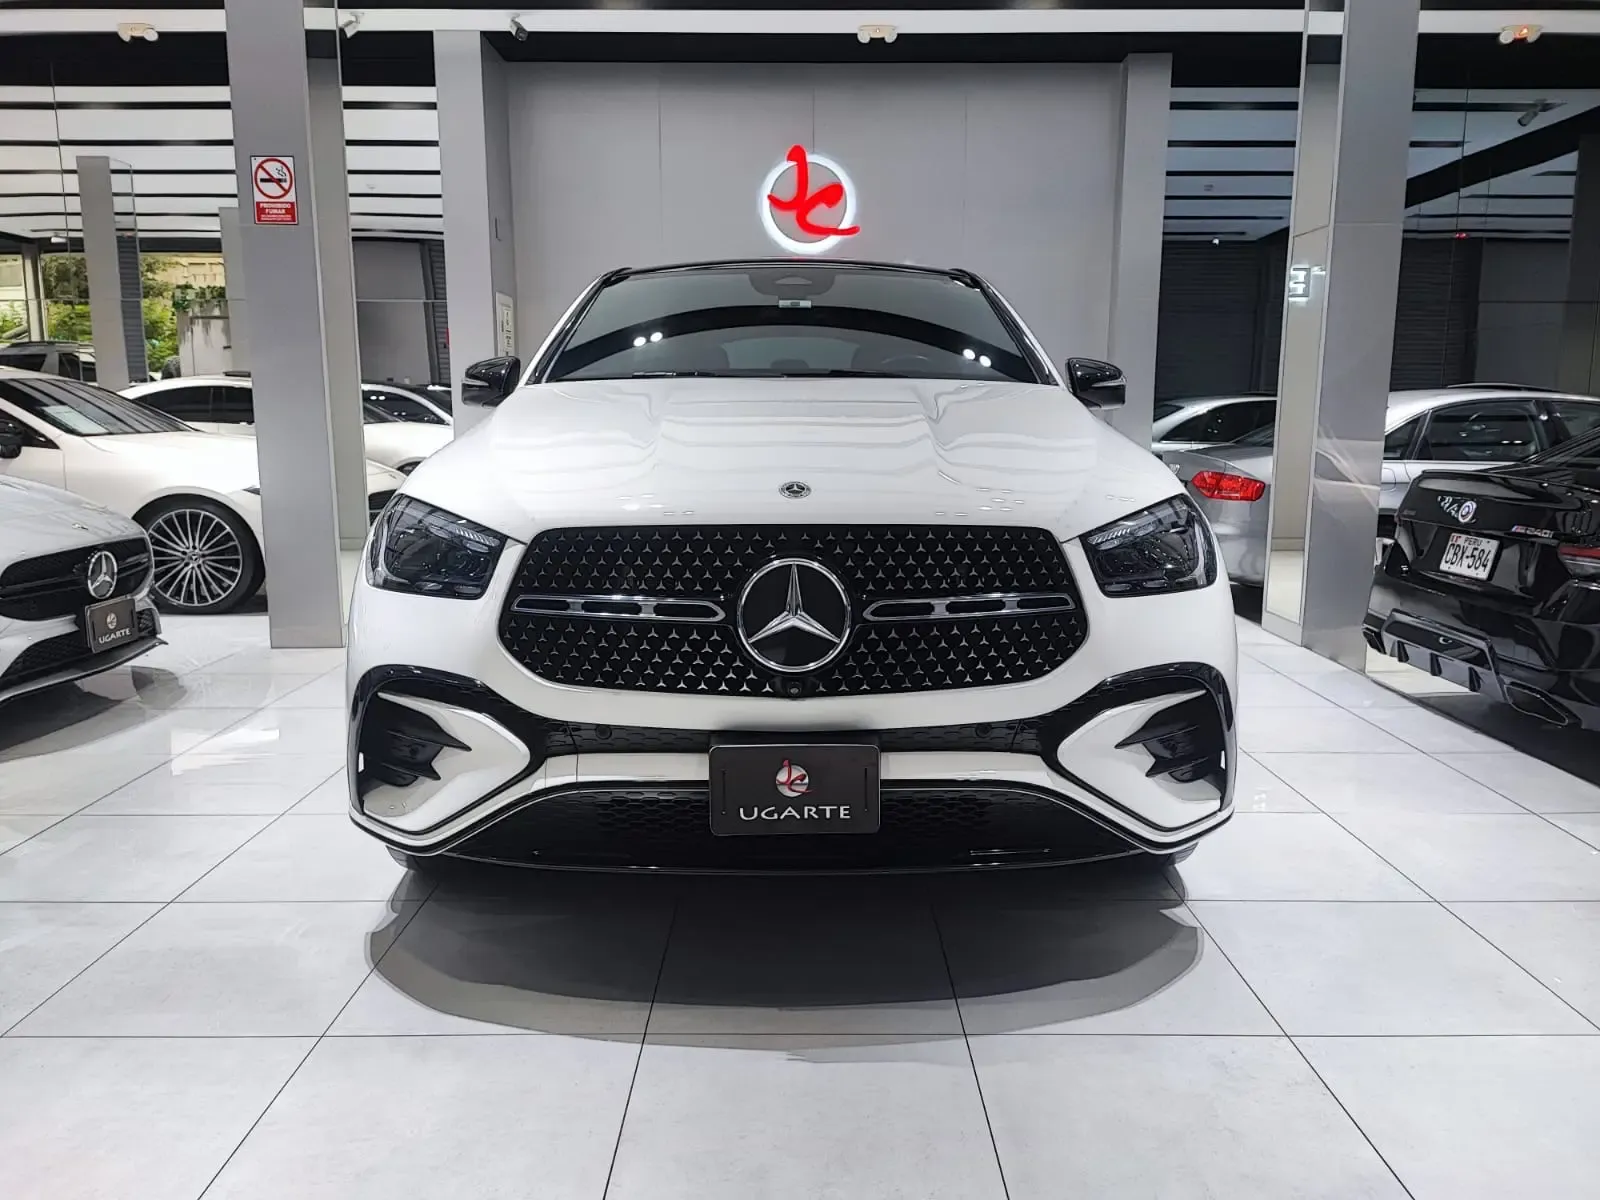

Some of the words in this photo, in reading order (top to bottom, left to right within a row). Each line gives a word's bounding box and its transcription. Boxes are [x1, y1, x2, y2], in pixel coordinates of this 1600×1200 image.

[1443, 543, 1492, 573] CBX-584
[98, 628, 131, 644] UGARTE
[739, 805, 850, 820] UGARTE
